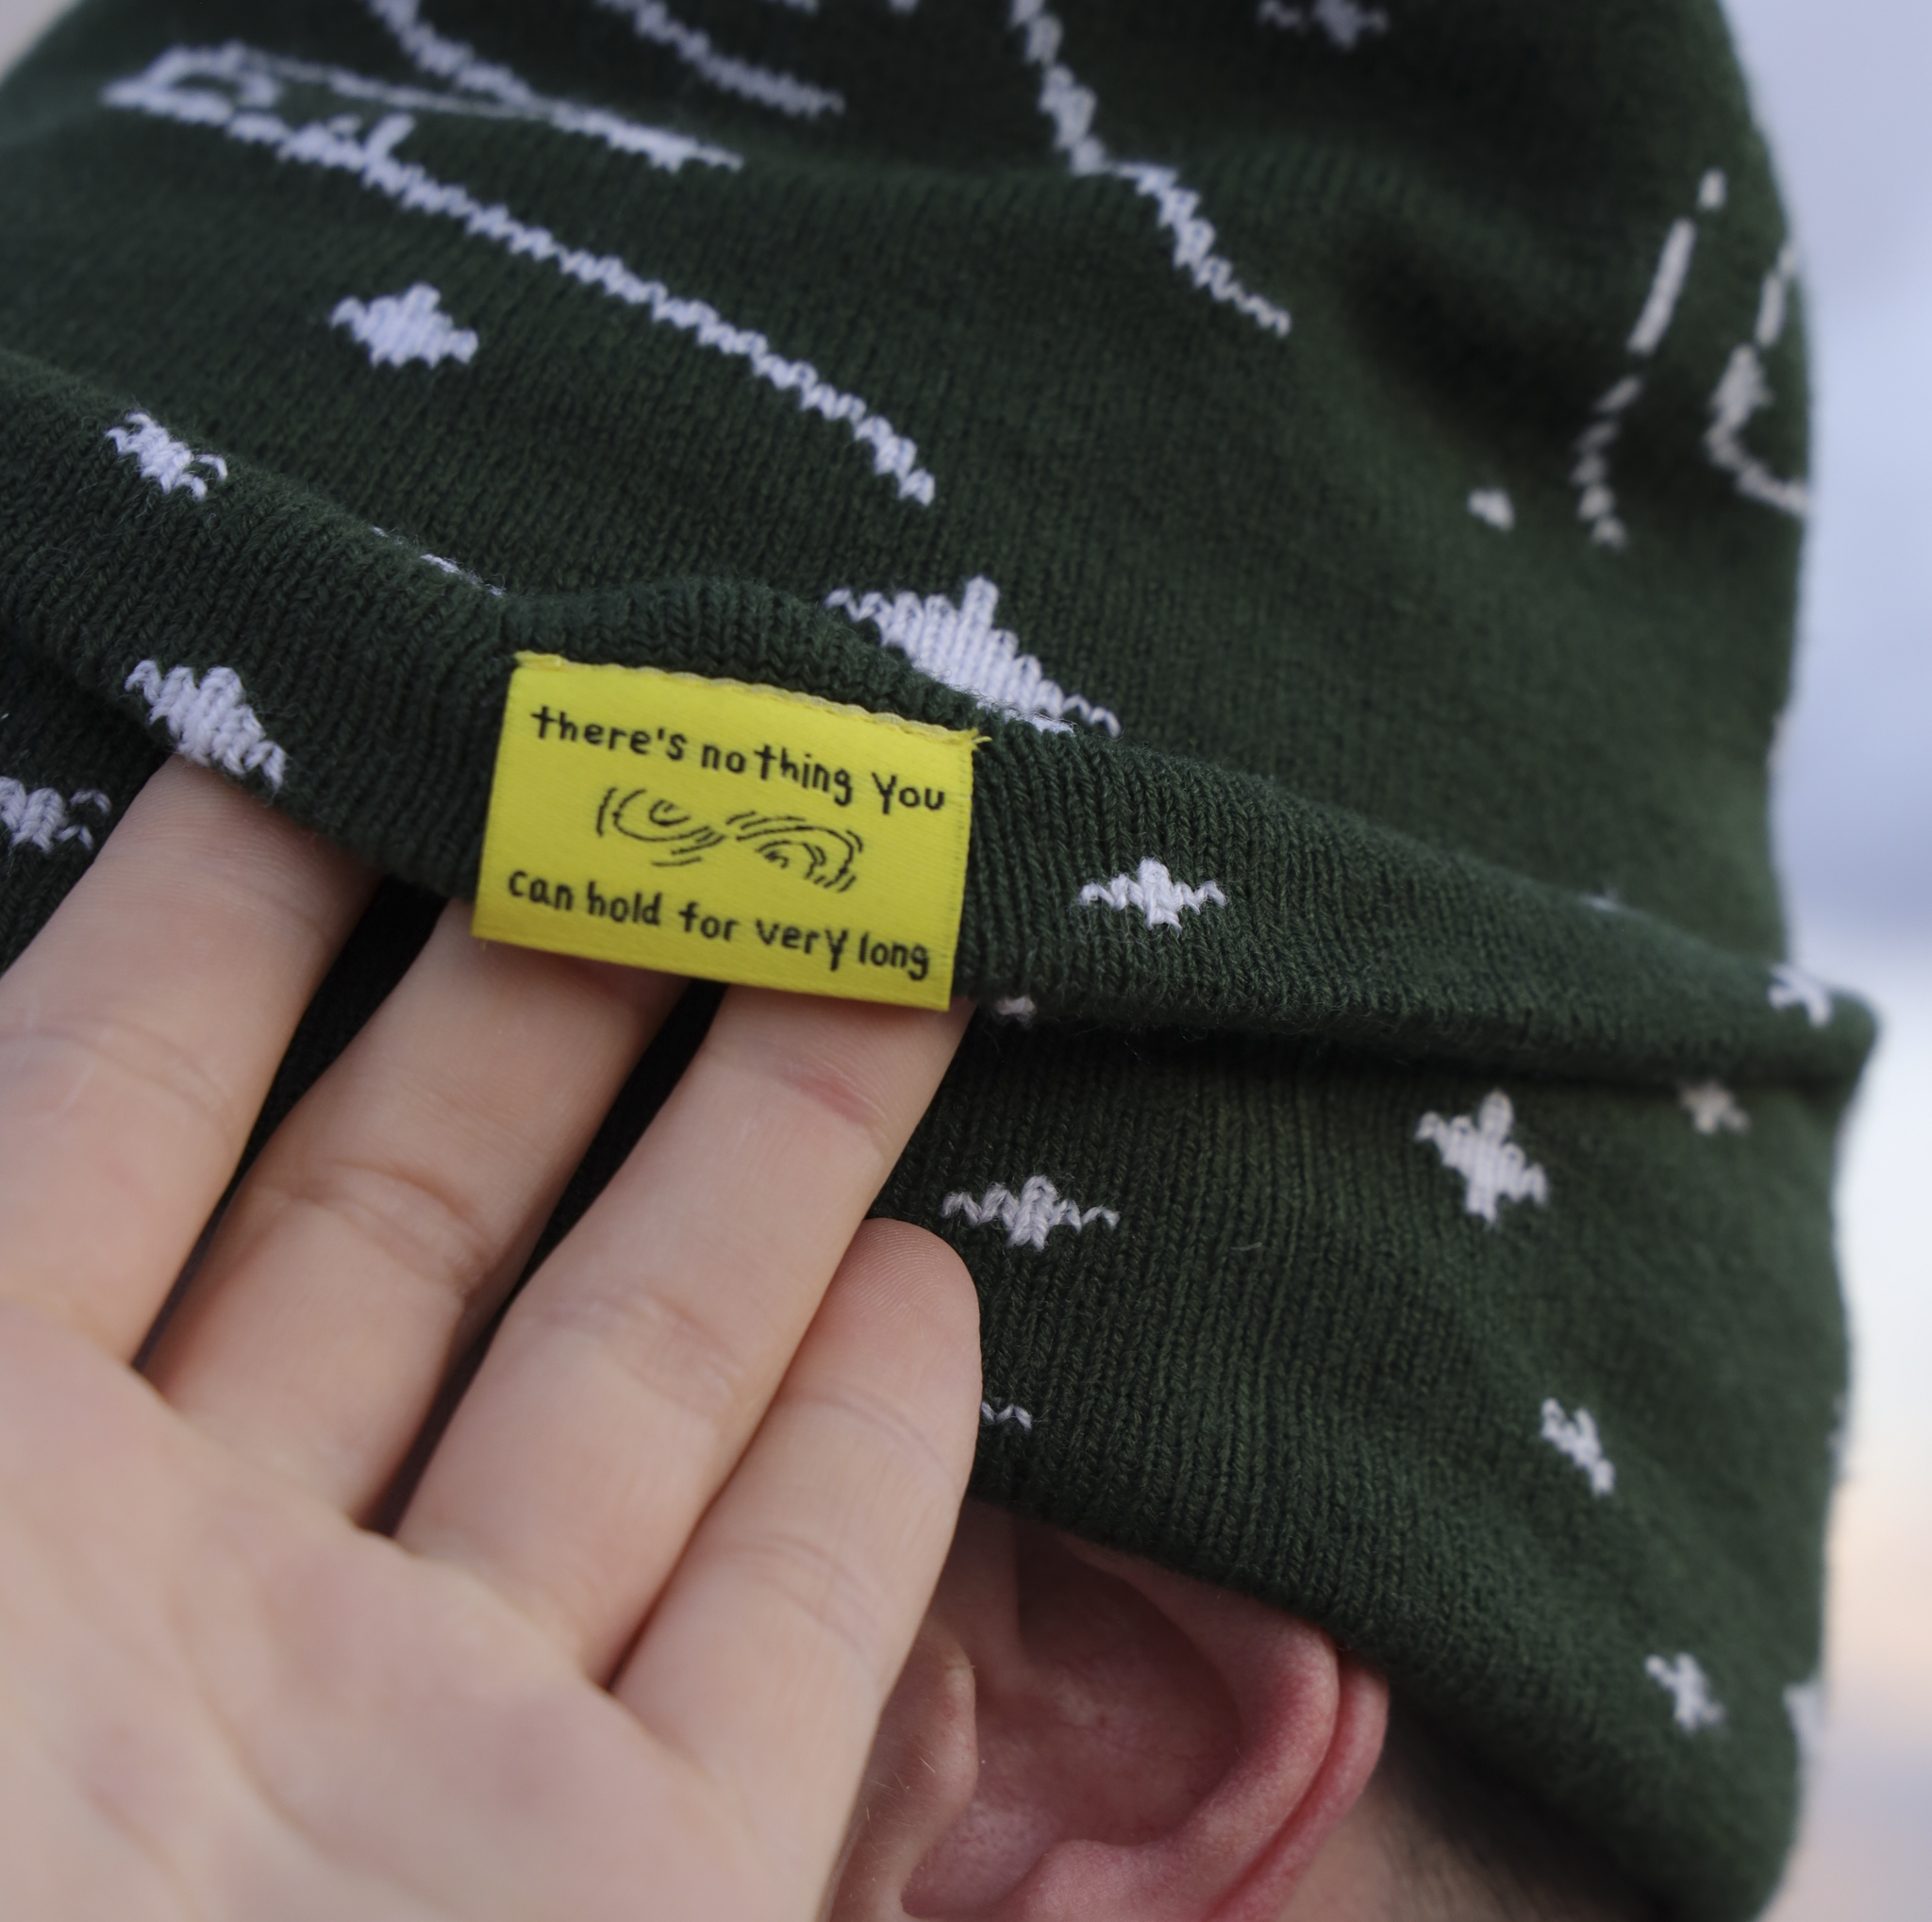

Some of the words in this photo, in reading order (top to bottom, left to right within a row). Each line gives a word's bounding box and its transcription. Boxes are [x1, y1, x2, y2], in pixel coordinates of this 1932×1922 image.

[530, 704, 688, 761] there's
[700, 744, 855, 808] nothing
[507, 869, 575, 912] can
[585, 879, 663, 928] hold
[676, 900, 741, 943] for
[755, 918, 850, 973] very
[857, 931, 931, 983] long
